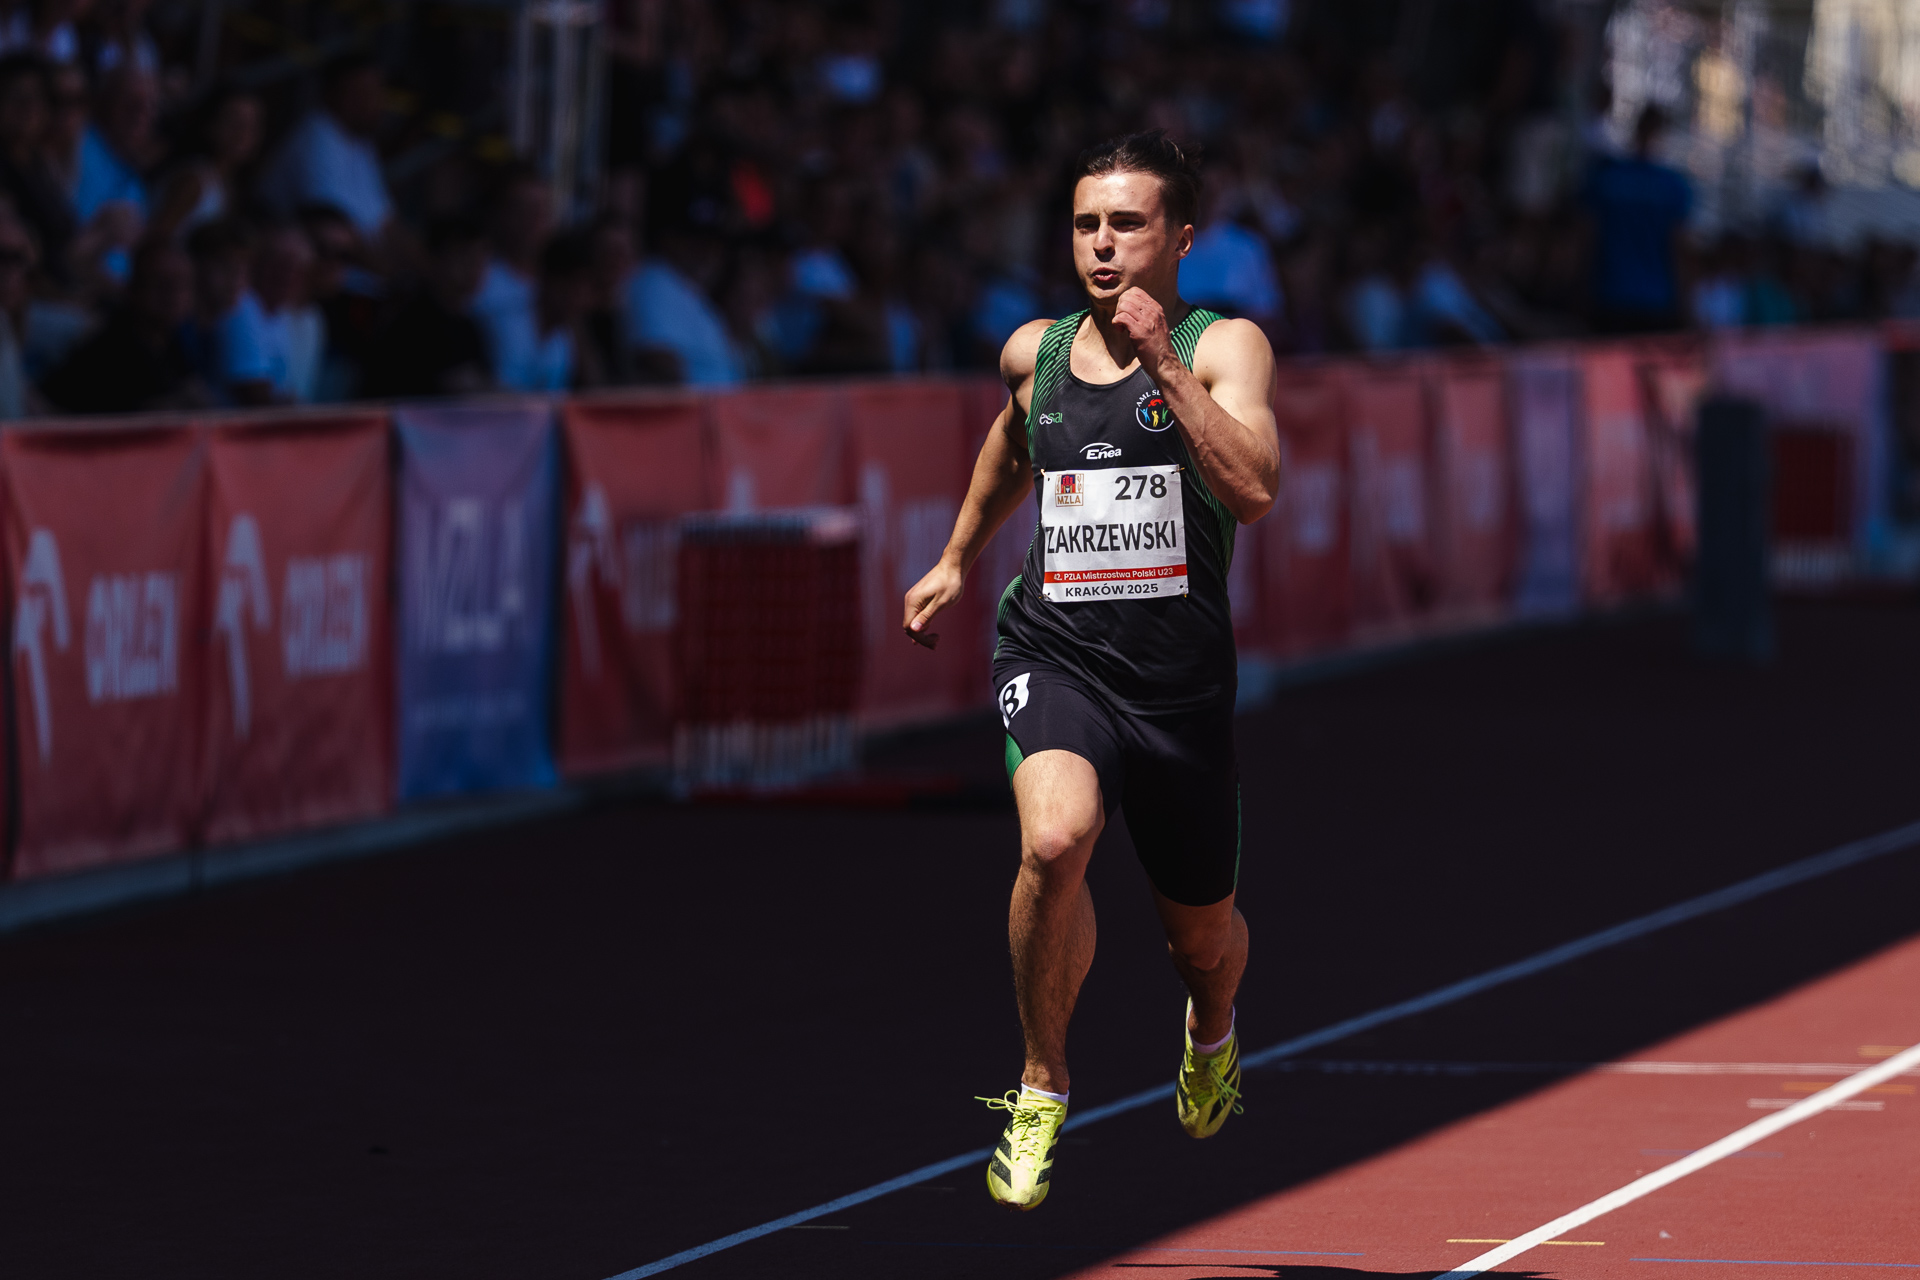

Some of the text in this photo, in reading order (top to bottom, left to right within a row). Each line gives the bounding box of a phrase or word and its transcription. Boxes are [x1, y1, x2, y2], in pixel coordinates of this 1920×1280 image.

[1136, 391, 1152, 407] AML
[1086, 448, 1122, 460] Enea
[1115, 474, 1167, 500] 278
[1057, 495, 1081, 504] MZLA
[1045, 520, 1177, 554] ZAKRZEWSKI
[1053, 567, 1174, 581] 42. PZLA Mistrzostwa Polski U23
[1065, 583, 1159, 597] KRAKÓW 2025
